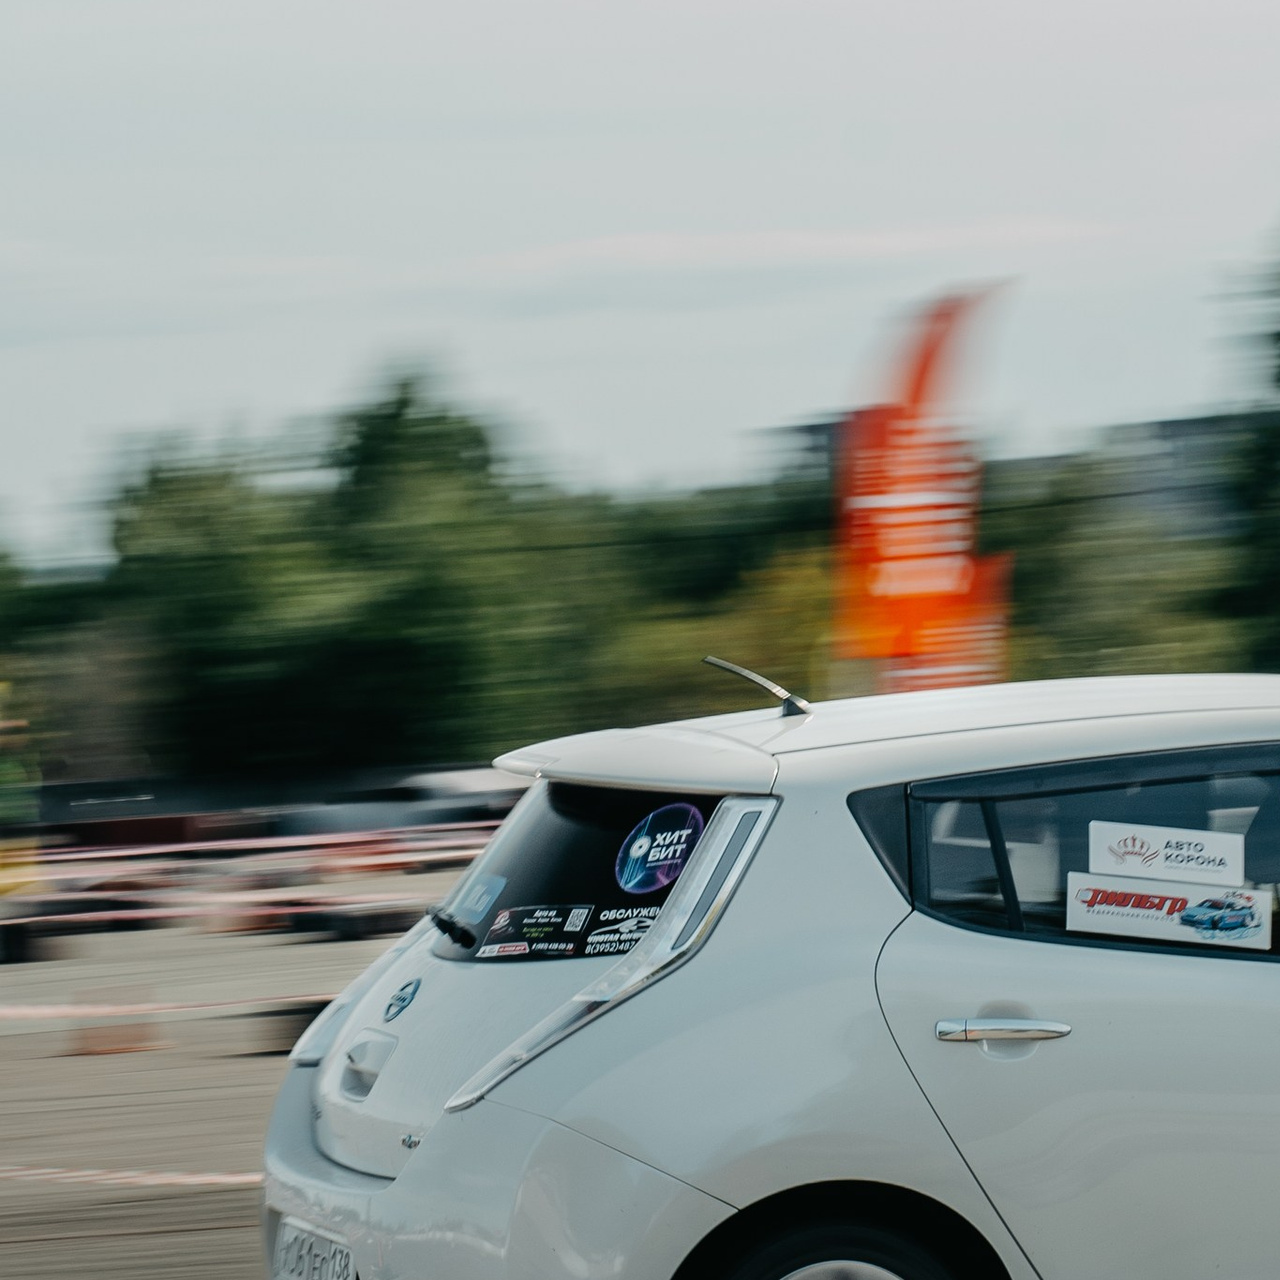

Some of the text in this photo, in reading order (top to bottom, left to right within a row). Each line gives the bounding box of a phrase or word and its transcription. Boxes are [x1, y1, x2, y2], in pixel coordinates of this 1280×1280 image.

[652, 829, 692, 847] ХИТ
[1164, 840, 1205, 853] АВТО
[647, 843, 686, 862] БИТ
[1164, 852, 1228, 868] КОРОНА
